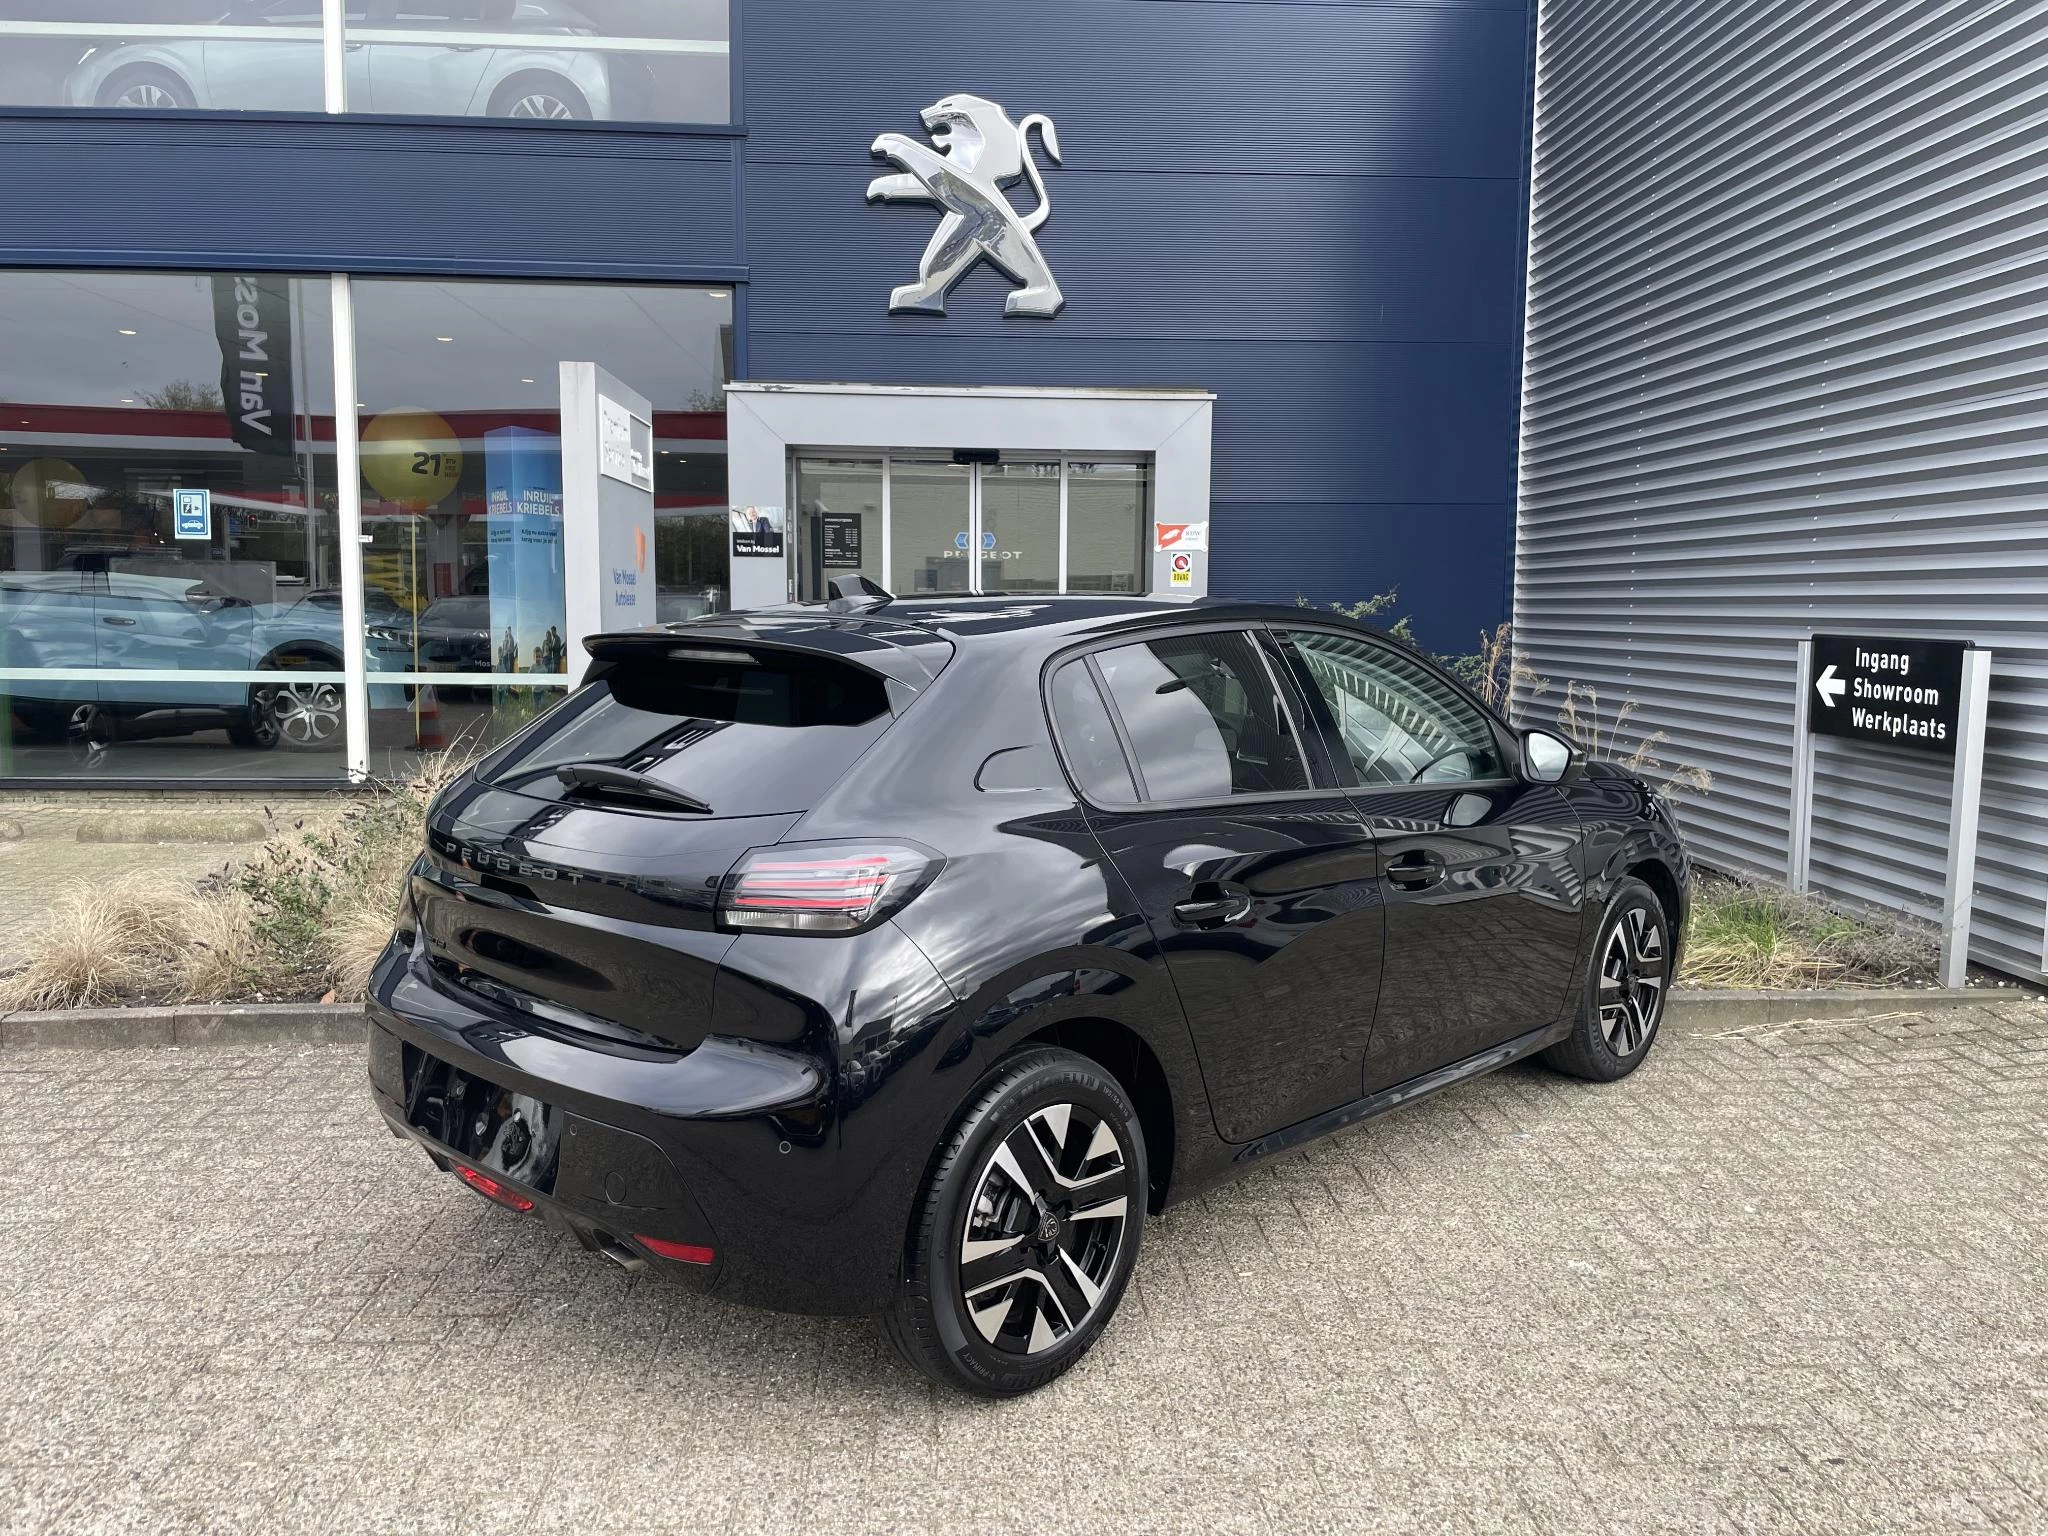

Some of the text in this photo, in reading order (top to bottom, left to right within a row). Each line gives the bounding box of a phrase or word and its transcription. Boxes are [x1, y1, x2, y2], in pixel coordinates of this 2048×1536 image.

[411, 451, 441, 477] 21
[517, 501, 560, 517] KRIEBELS
[523, 490, 554, 504] INRUIL
[736, 544, 780, 553] Van Mossel
[1855, 646, 1910, 676] Ingang
[1852, 676, 1939, 706] Showroom
[1851, 706, 1947, 740] Werkplaats
[445, 841, 585, 886] PEUGEOT
